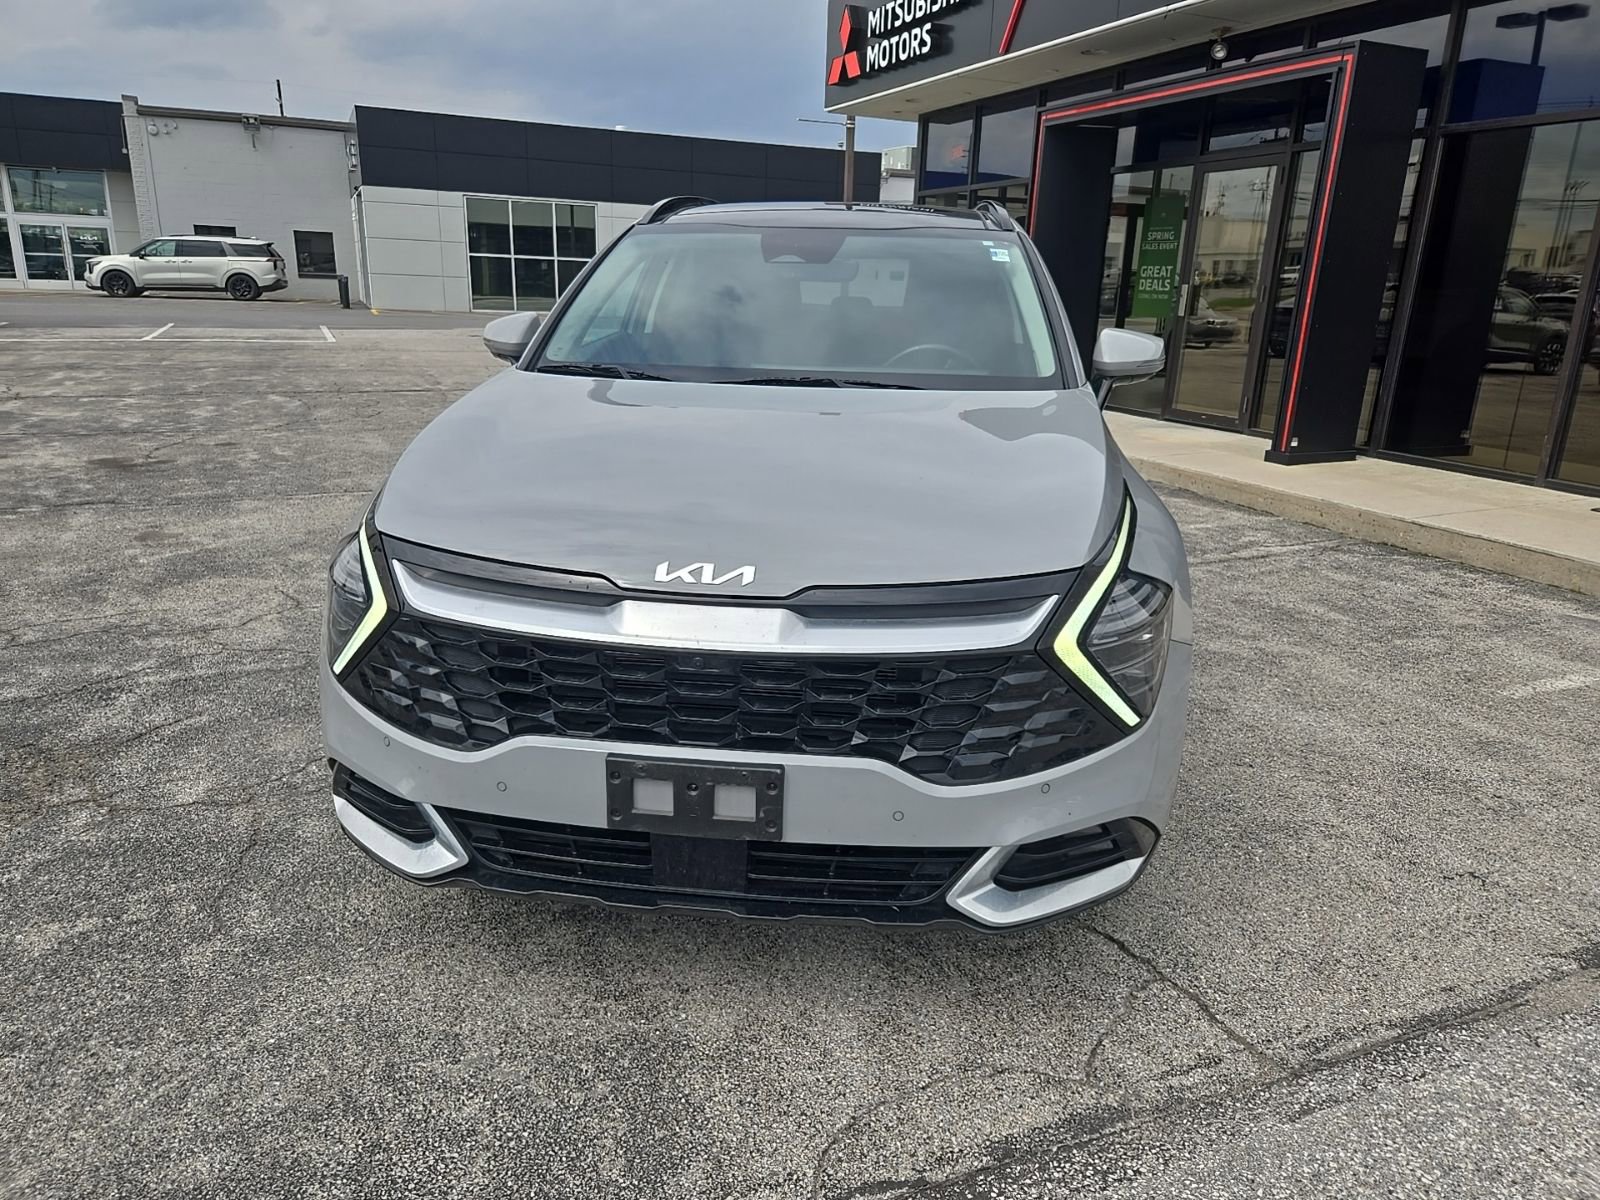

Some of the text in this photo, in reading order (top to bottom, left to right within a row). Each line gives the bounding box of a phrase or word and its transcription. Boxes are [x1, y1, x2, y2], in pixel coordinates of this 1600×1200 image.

[866, 22, 932, 73] MOTORS
[1147, 231, 1175, 241] SPRING
[1159, 242, 1178, 250] EVENT
[1140, 265, 1173, 277] GREAT
[1139, 279, 1170, 290] DEALS
[654, 560, 756, 587] KIA
